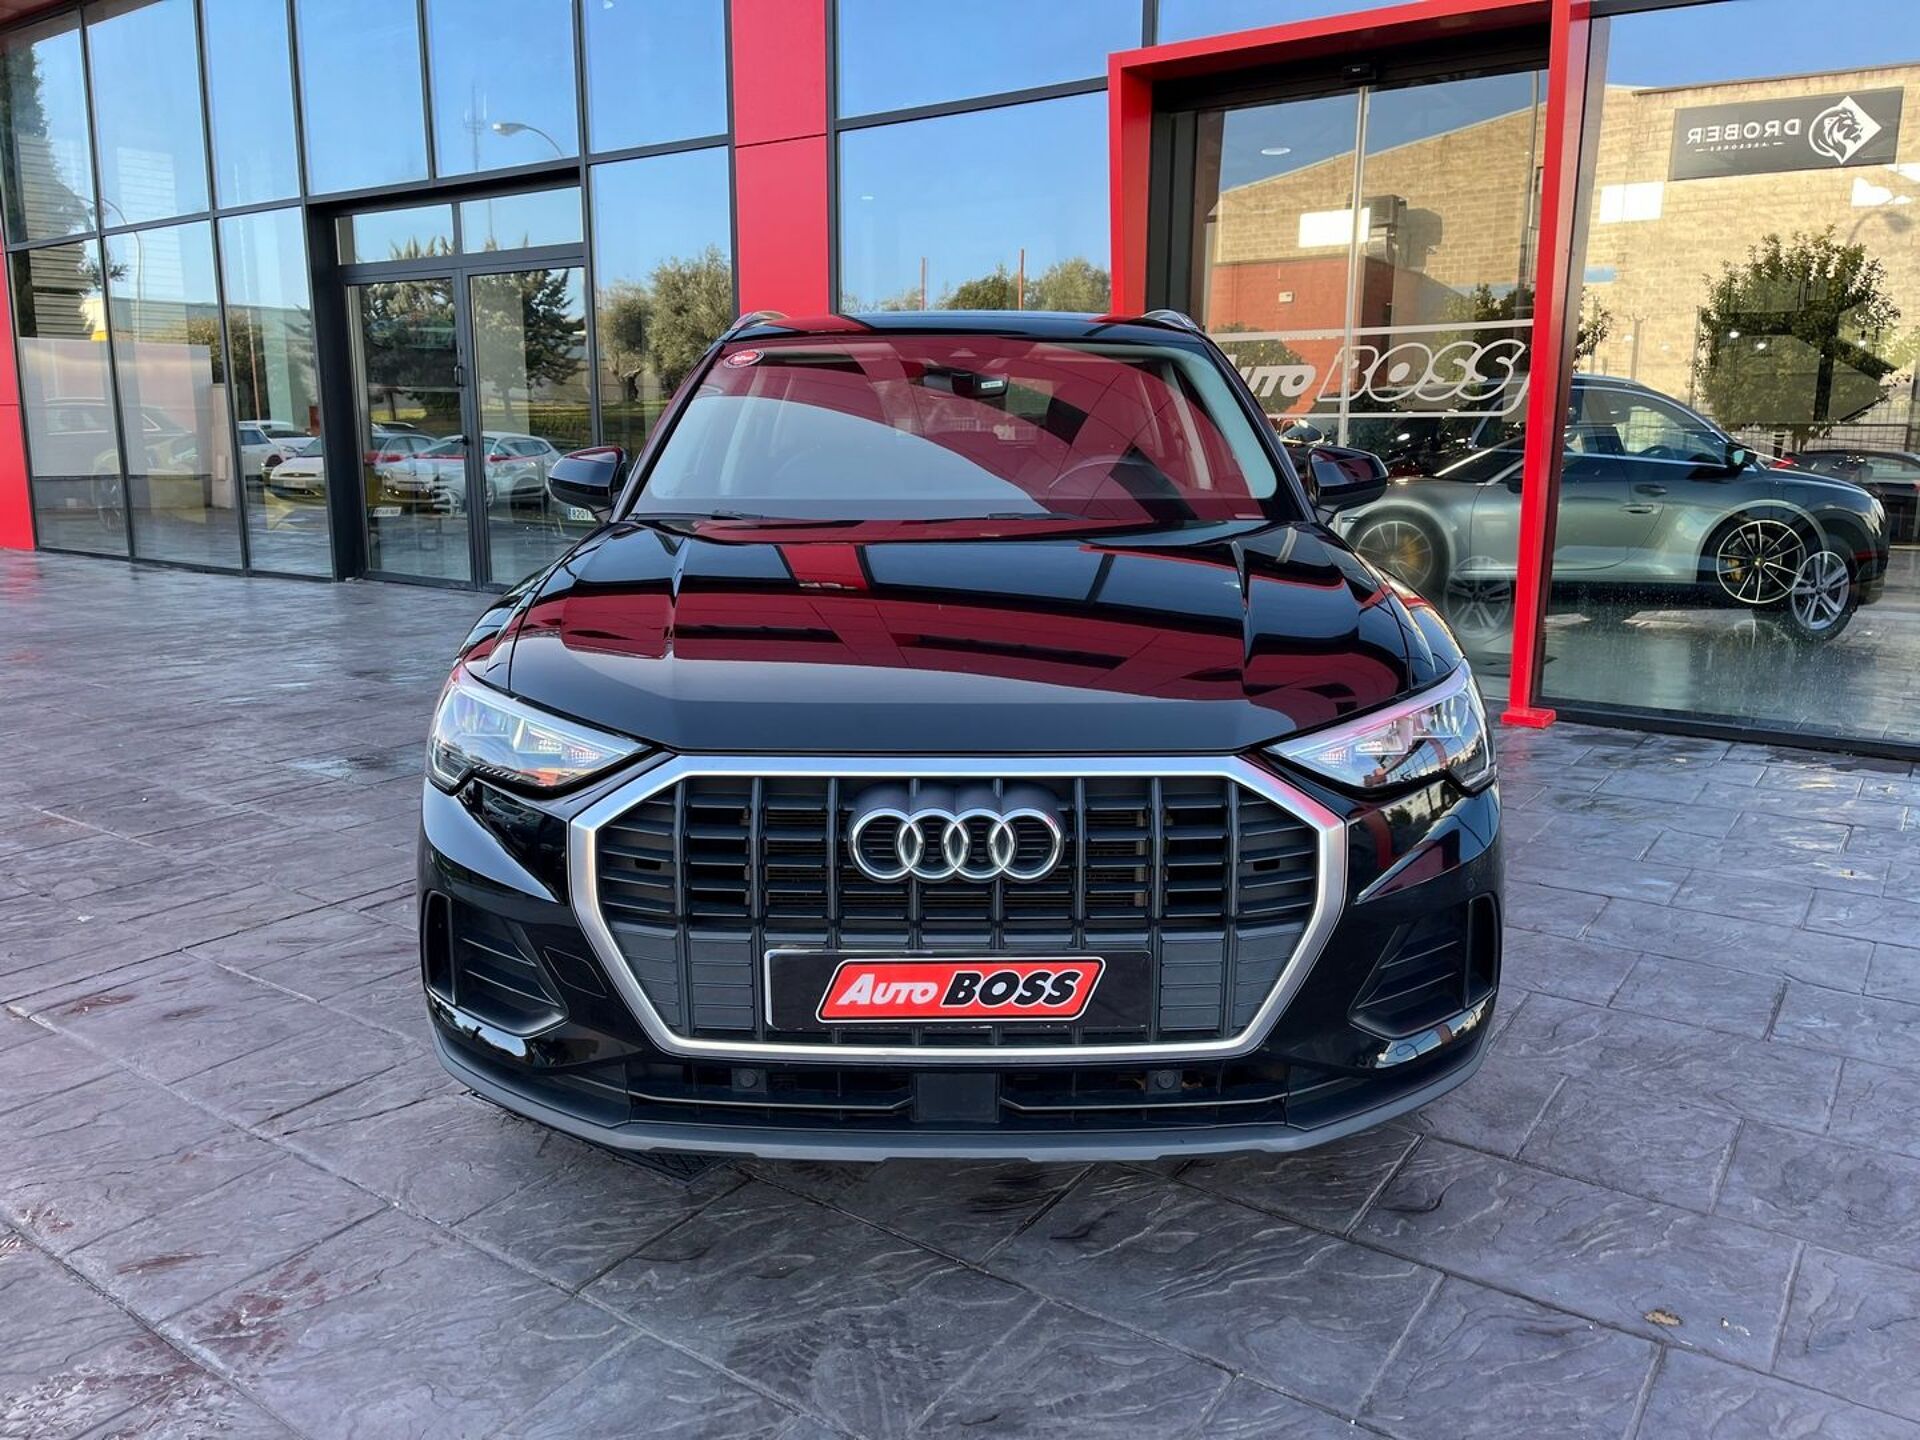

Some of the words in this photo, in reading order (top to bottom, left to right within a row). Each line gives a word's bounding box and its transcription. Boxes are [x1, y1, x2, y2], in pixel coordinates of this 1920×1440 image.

[1317, 340, 1526, 402] BOSS
[836, 974, 938, 1005] AUTO
[940, 969, 1085, 1009] BOSS
